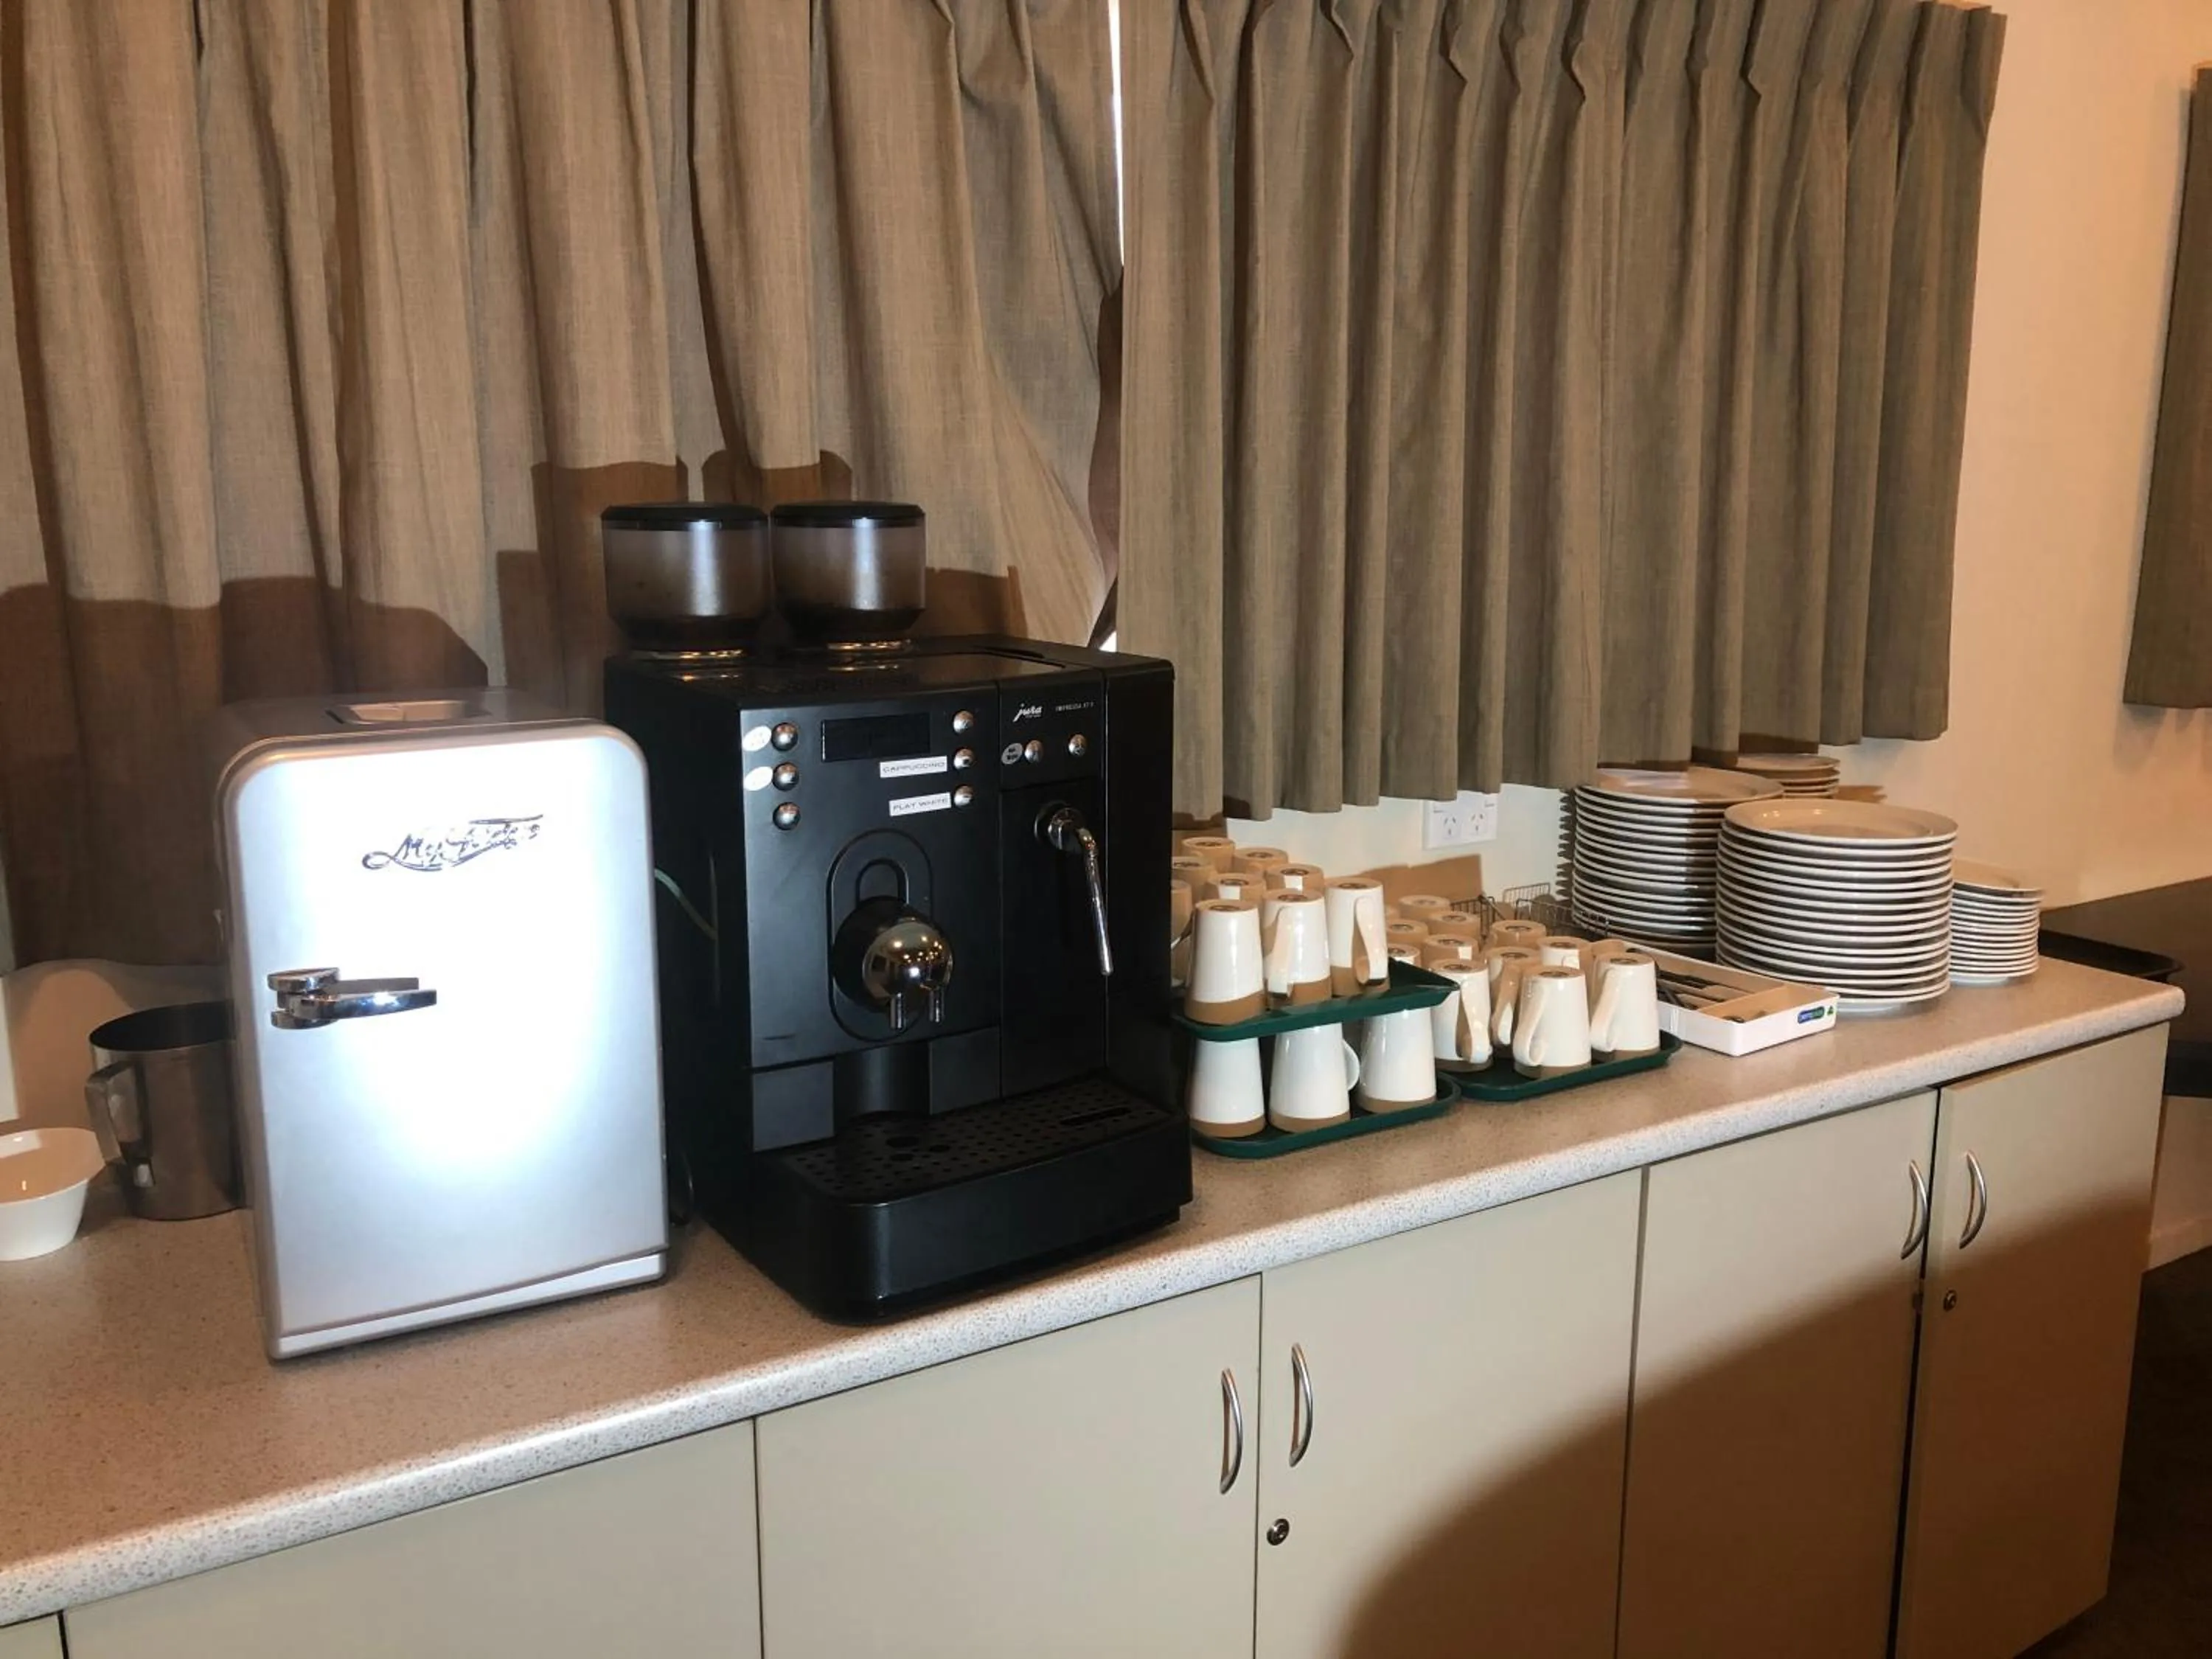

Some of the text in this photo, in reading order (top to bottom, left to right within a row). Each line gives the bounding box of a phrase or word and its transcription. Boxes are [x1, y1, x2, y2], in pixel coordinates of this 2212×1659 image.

[1012, 703, 1043, 723] jura
[883, 762, 945, 773] CAPPUCCINO
[917, 797, 948, 808] WHITE
